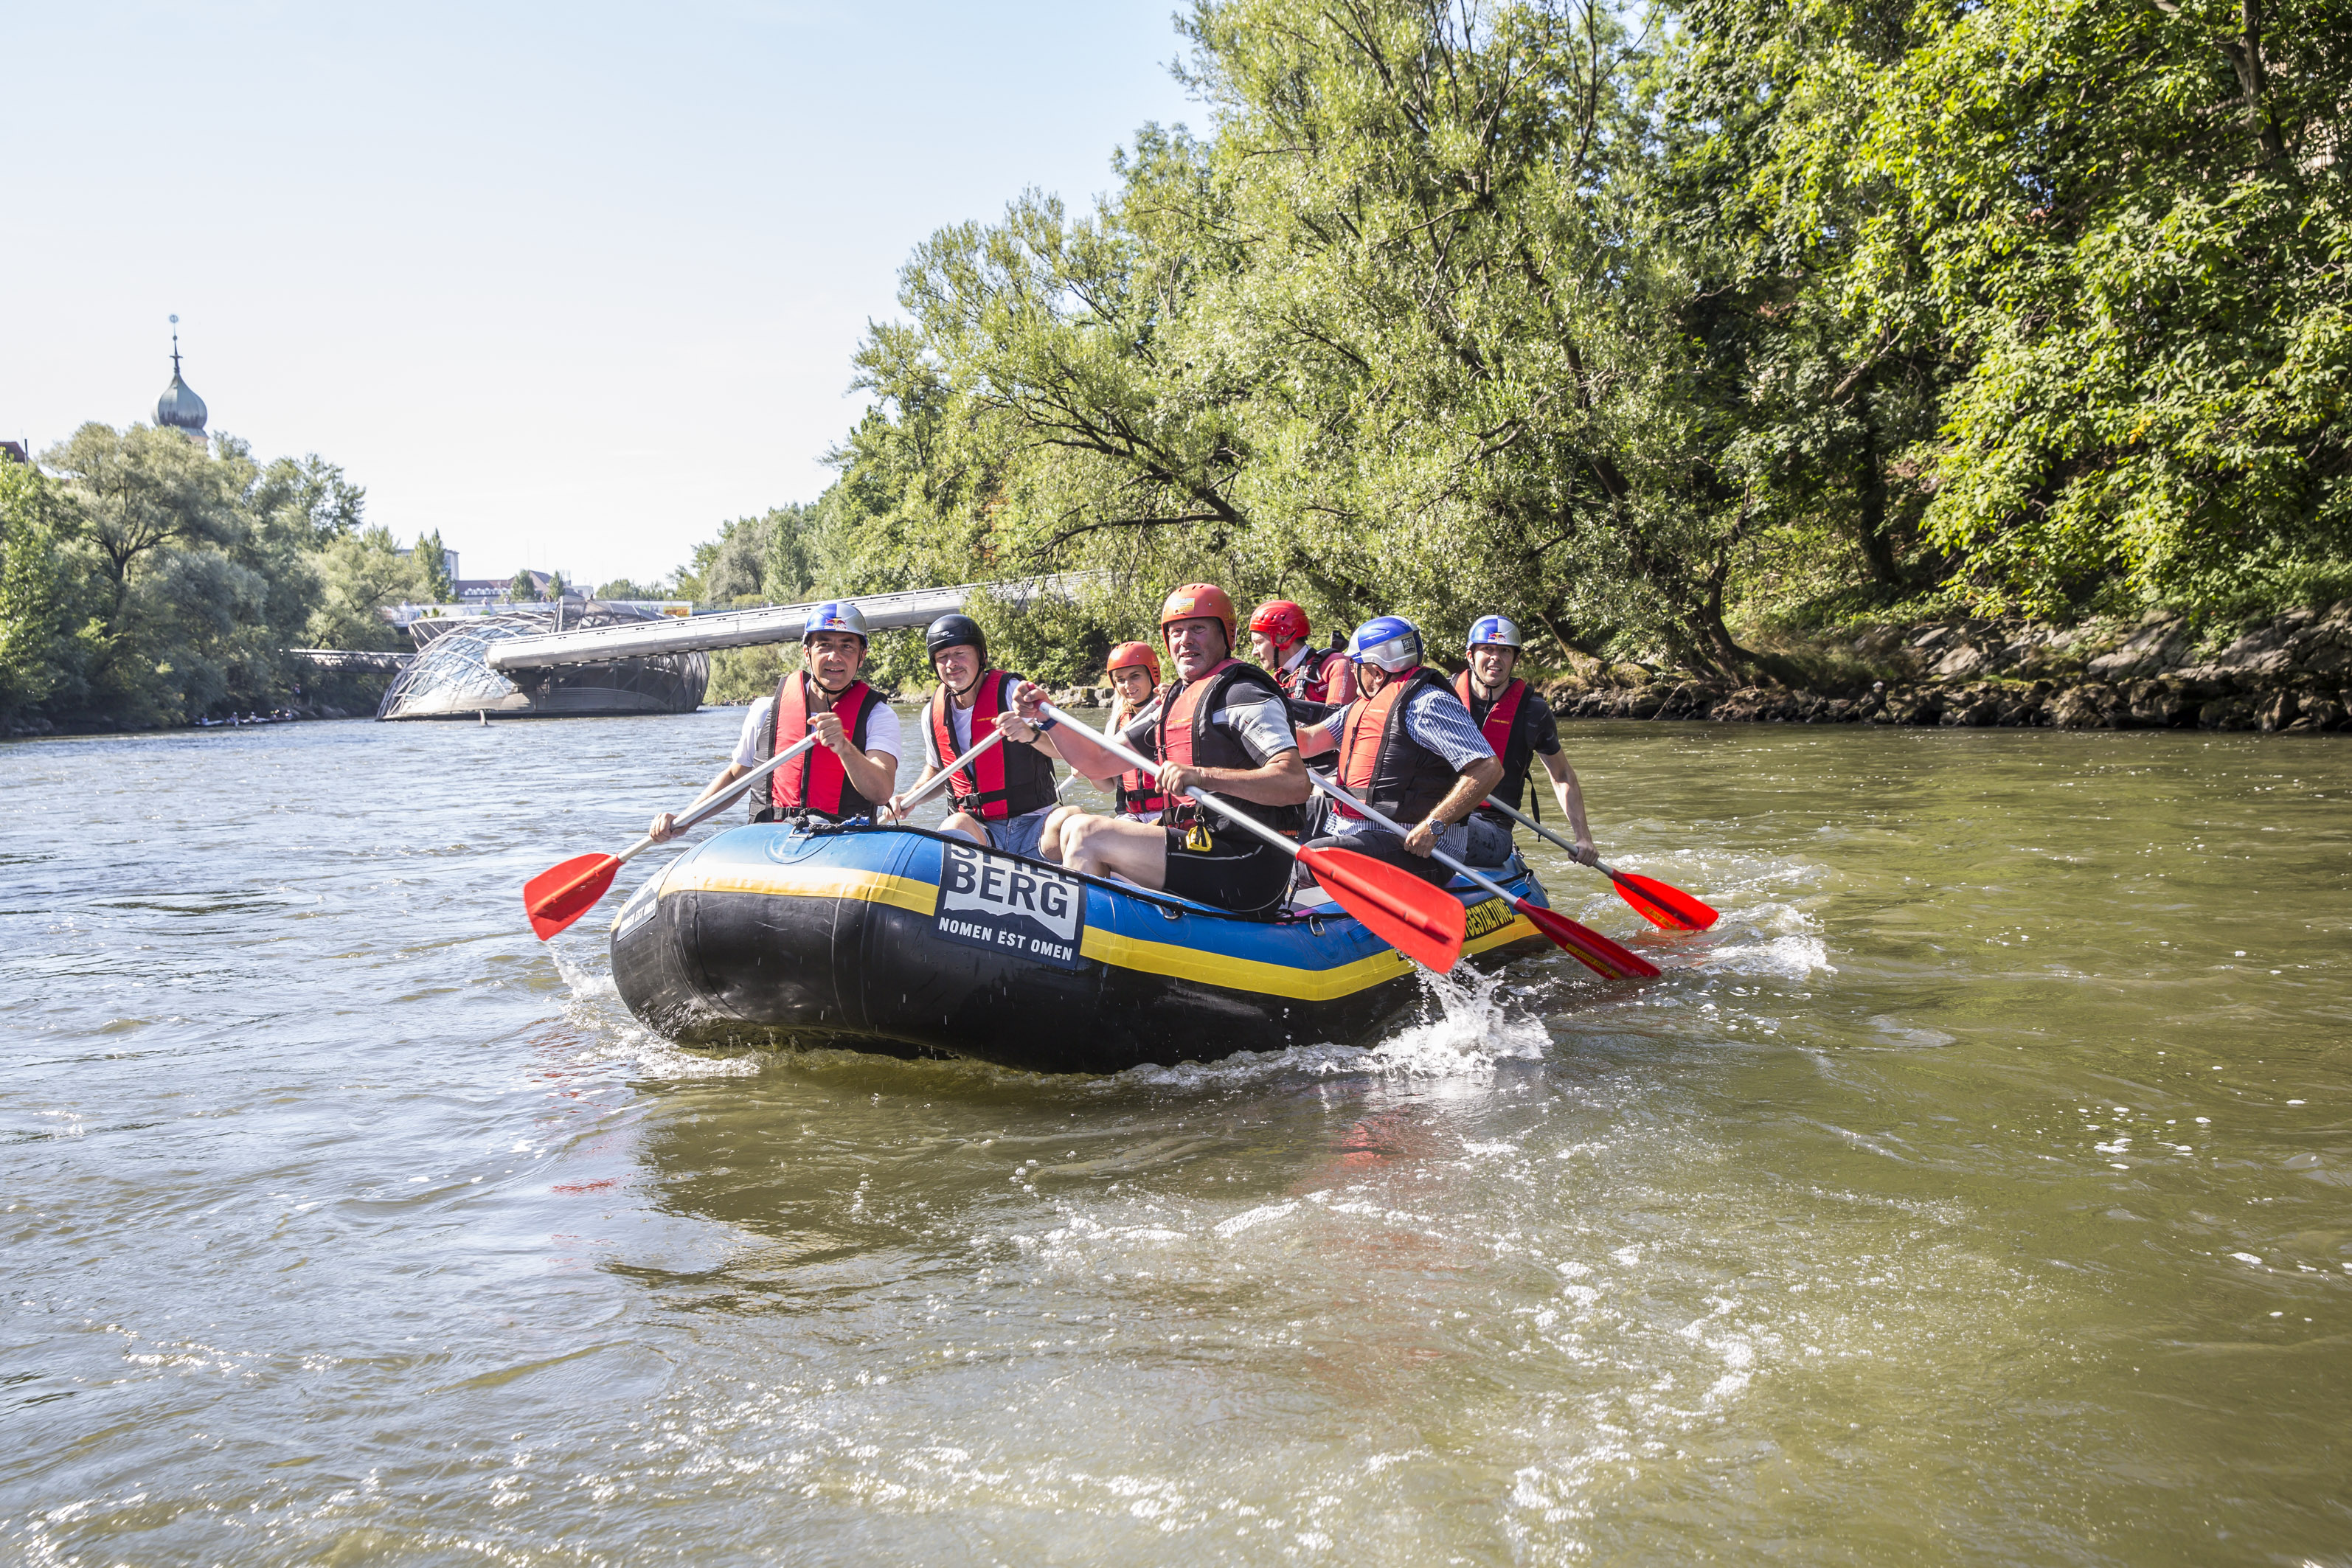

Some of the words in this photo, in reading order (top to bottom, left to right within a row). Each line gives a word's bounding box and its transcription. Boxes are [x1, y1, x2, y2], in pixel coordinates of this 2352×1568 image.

[949, 859, 1069, 920] BERG
[938, 917, 993, 941] NOMEN
[997, 930, 1026, 949] EST
[1030, 939, 1072, 961] OMEN
[1465, 897, 1513, 938] GESTALTUNG
